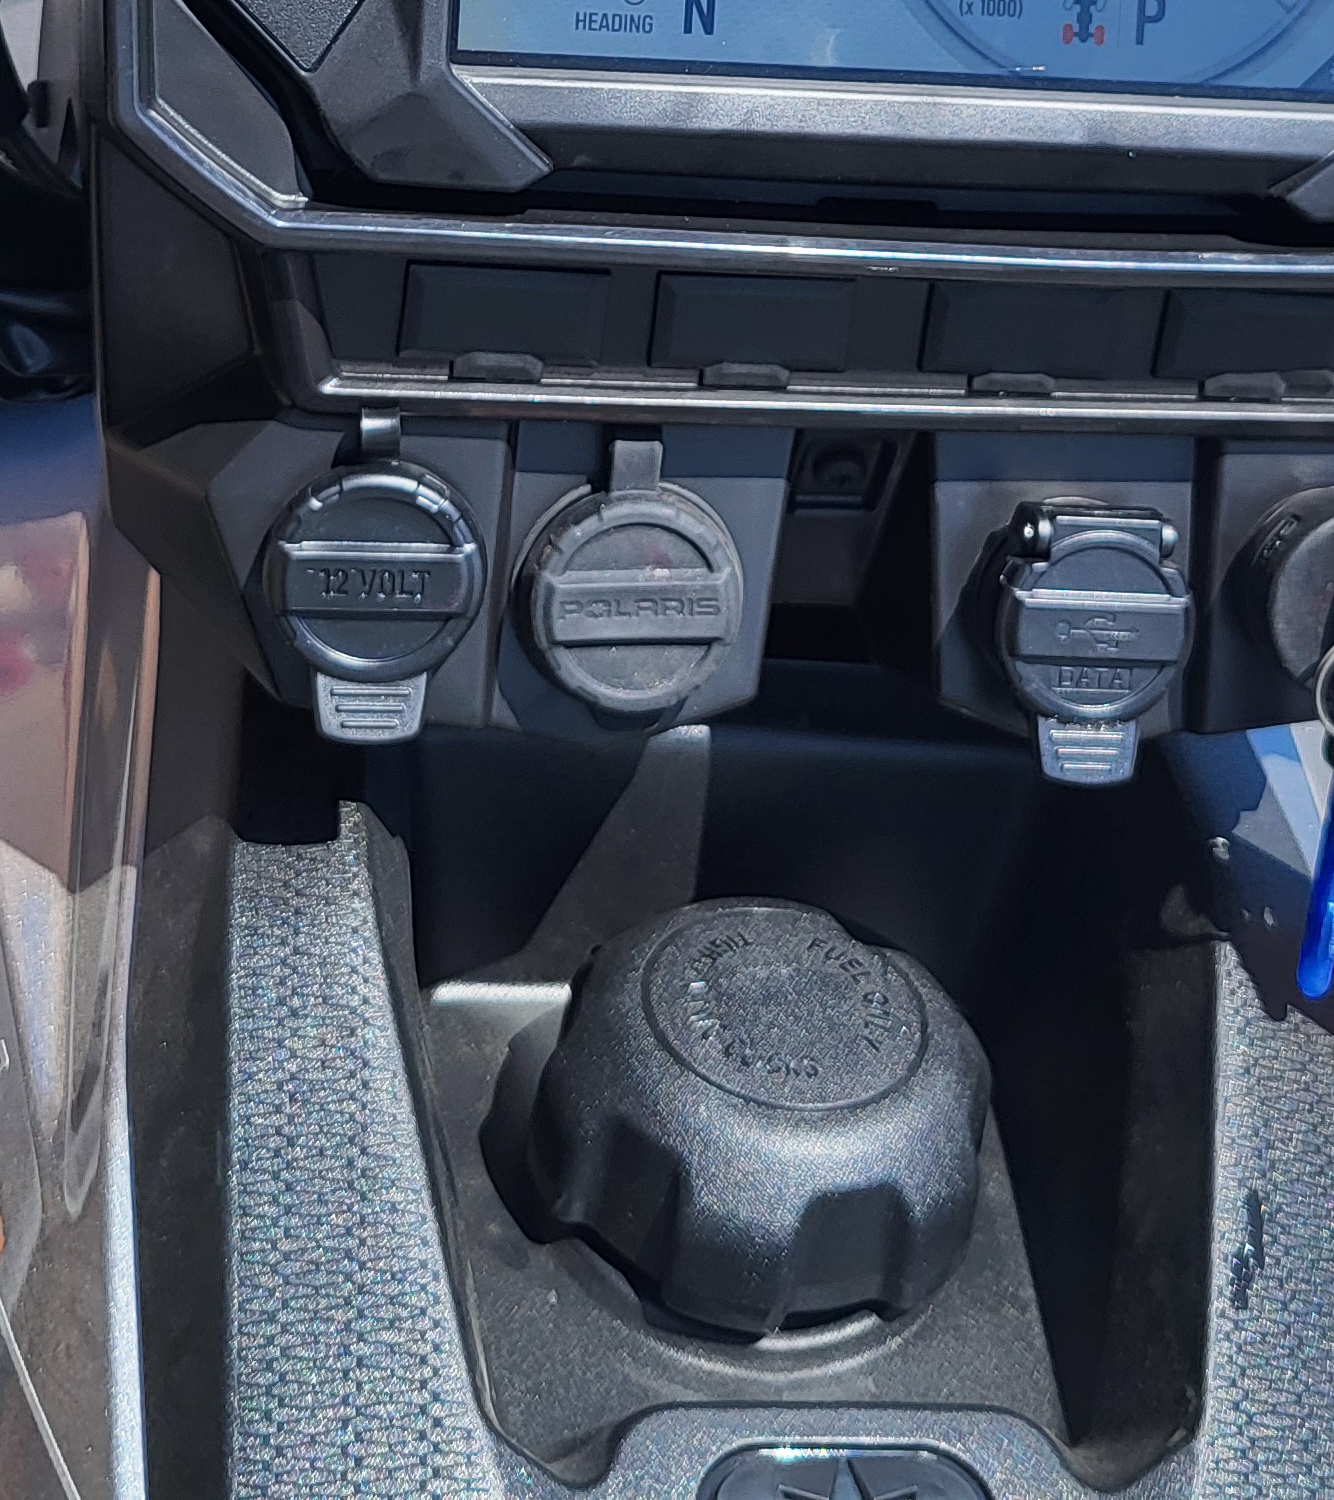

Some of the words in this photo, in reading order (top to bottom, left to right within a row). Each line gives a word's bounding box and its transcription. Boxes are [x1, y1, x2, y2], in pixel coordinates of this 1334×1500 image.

[575, 12, 654, 34] HEADING
[317, 566, 351, 599] 12
[362, 567, 432, 604] VOLT
[558, 596, 722, 621] POLARIS
[1056, 665, 1134, 690] DATA
